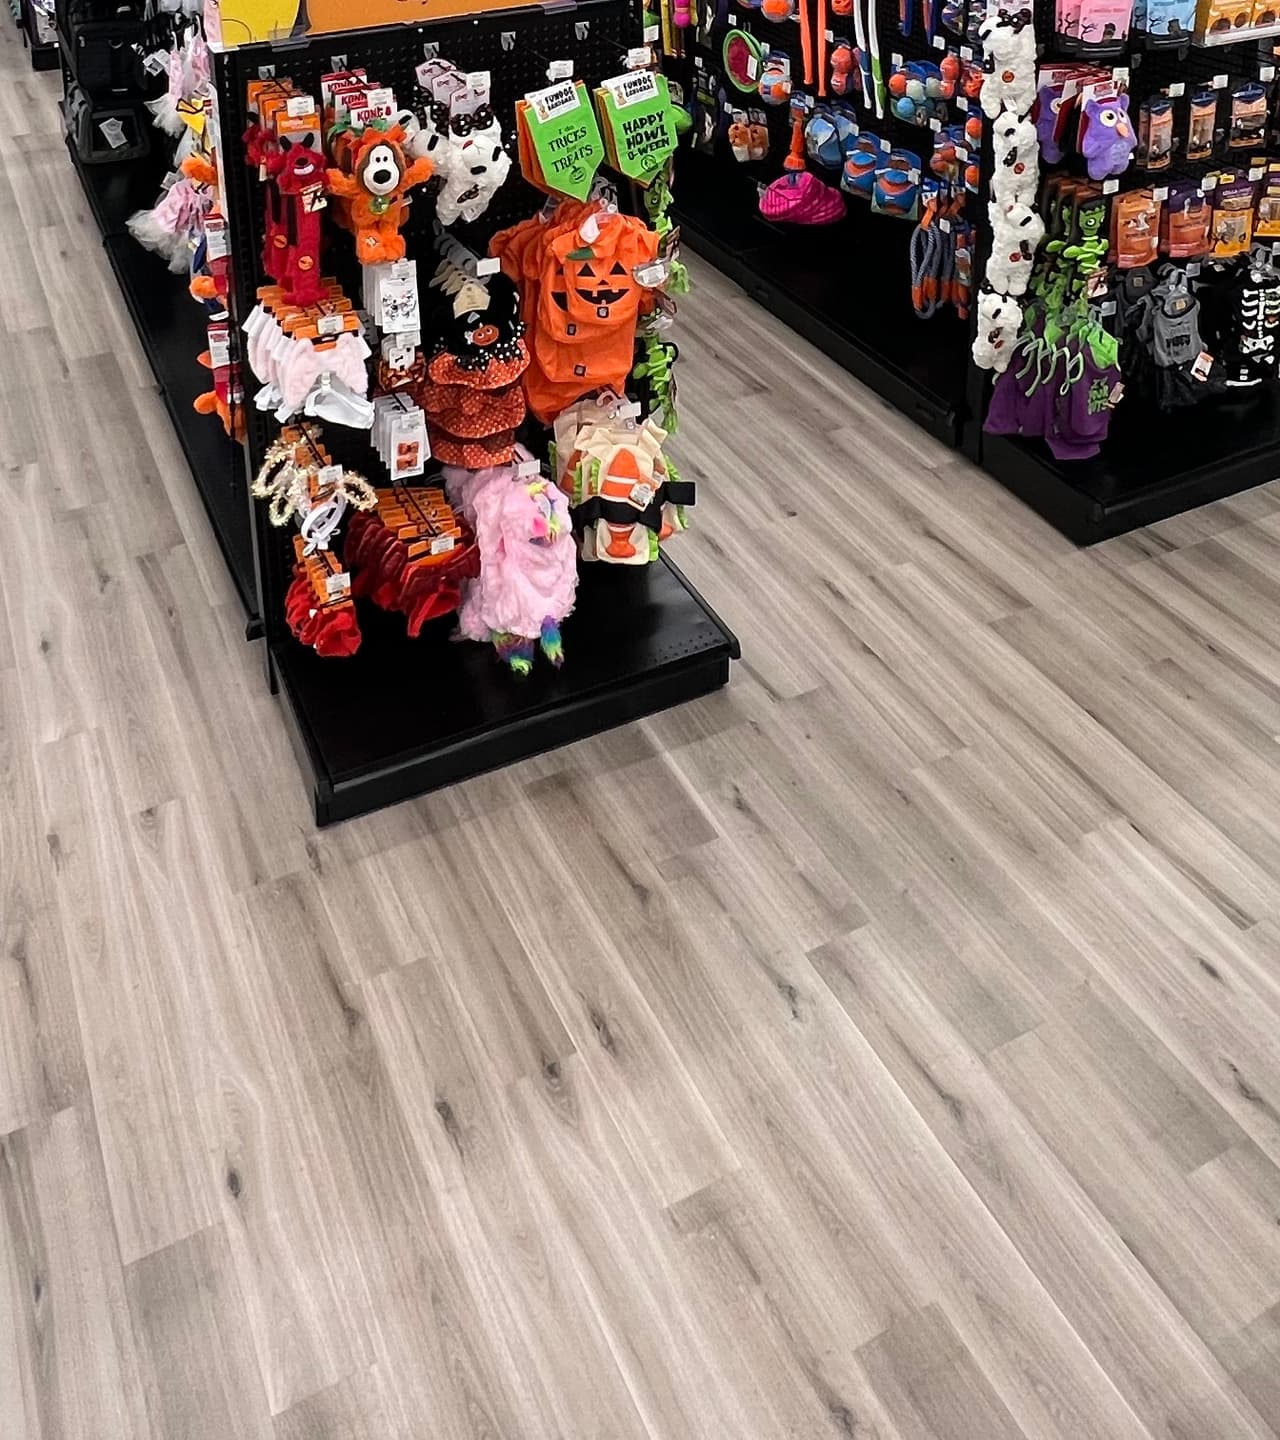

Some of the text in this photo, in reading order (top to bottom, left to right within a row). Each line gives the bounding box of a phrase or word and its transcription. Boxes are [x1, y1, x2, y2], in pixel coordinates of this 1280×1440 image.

[357, 109, 383, 122] KONG
[623, 111, 665, 135] HAPPY
[548, 126, 588, 152] TRICKS
[627, 125, 668, 150] HOWL
[627, 137, 671, 161] O-WEEN
[552, 144, 594, 173] TREATS
